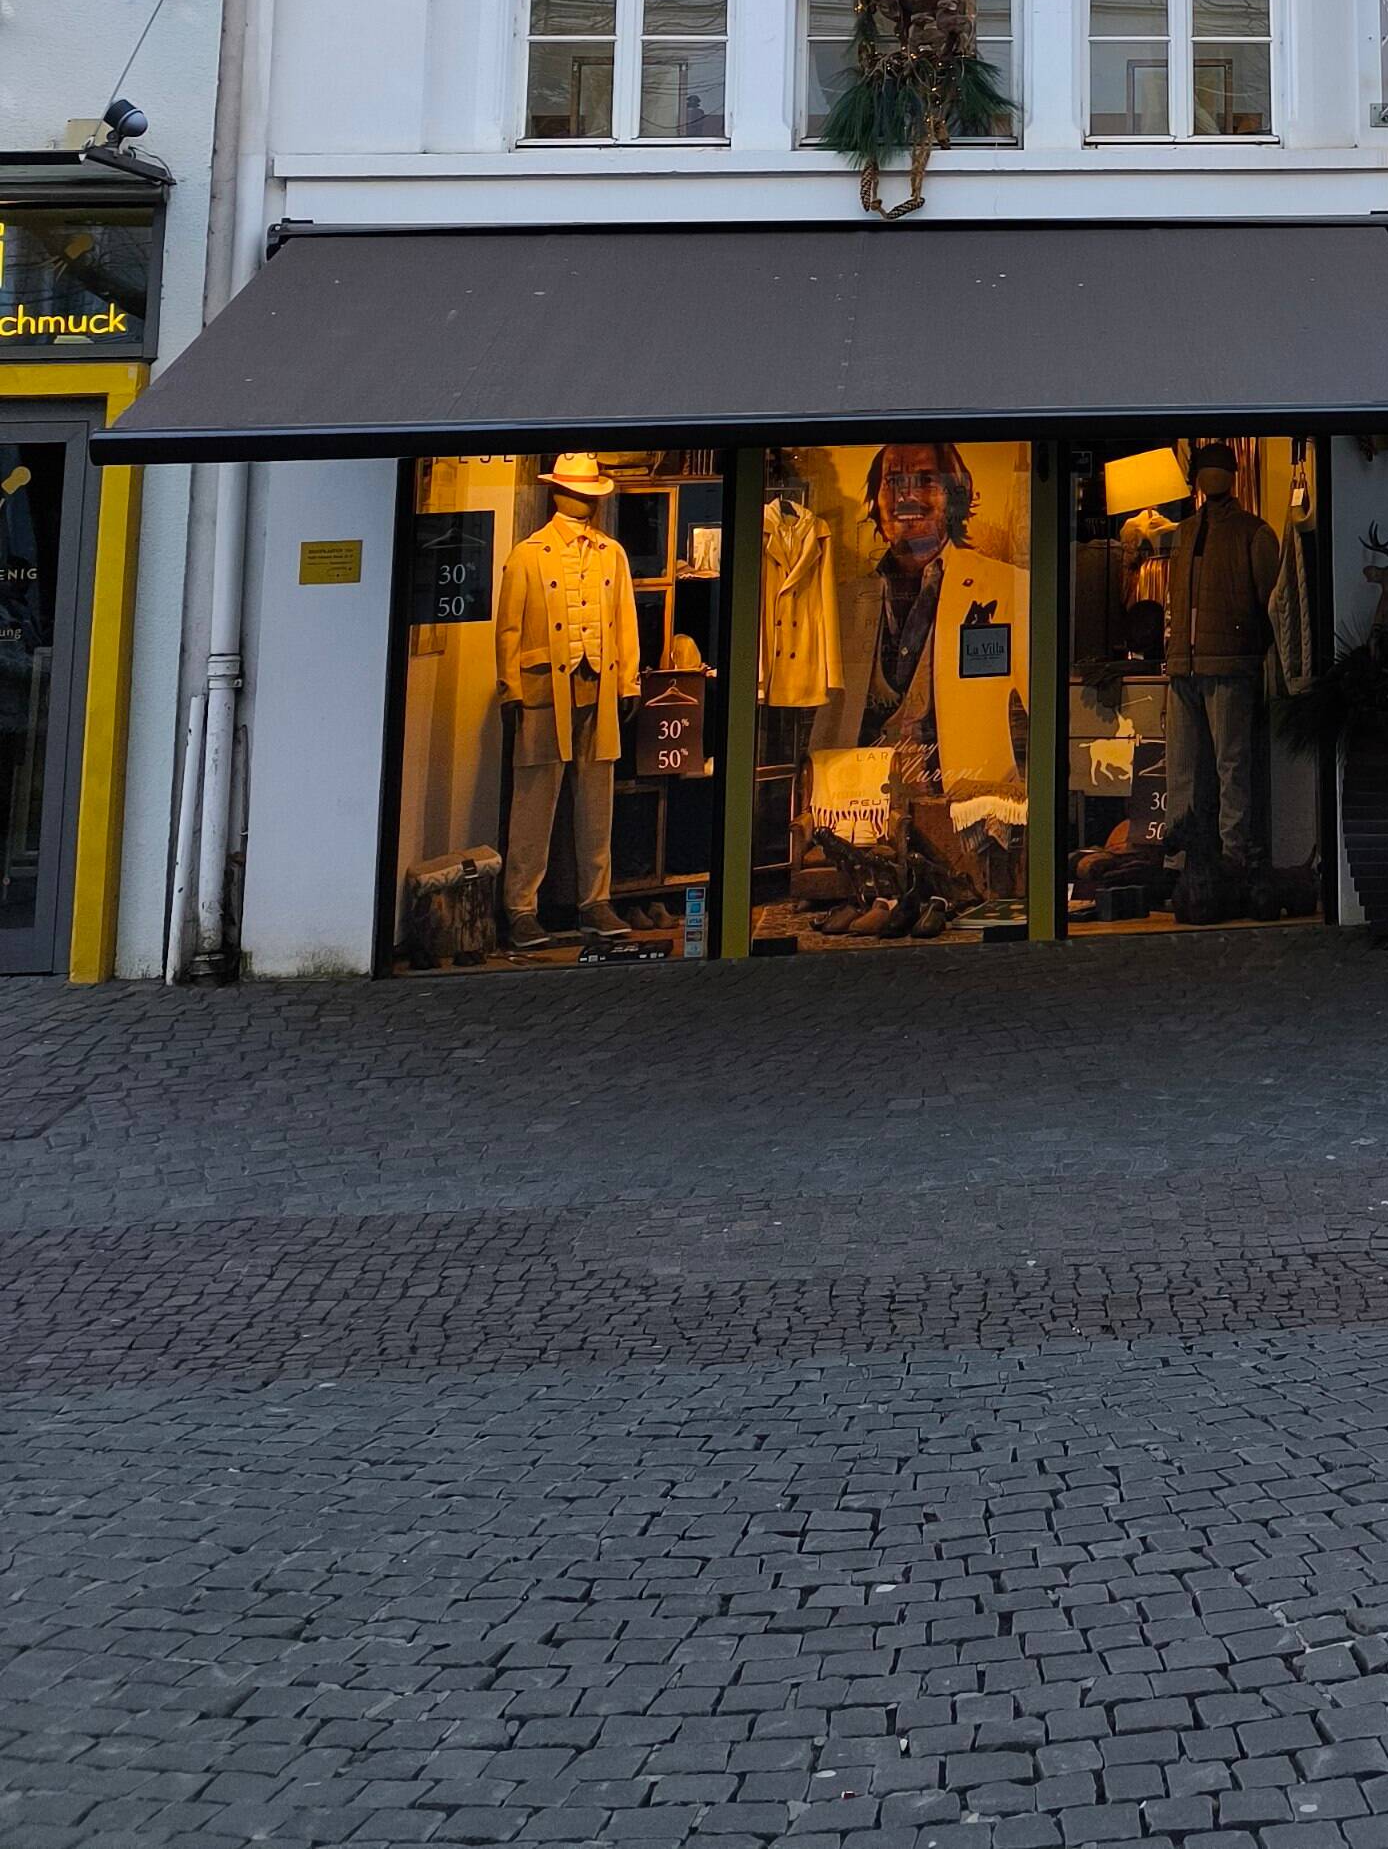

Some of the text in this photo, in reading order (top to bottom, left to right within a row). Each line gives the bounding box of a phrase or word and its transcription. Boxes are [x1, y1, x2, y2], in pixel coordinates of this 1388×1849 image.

[965, 641, 1005, 655] La Villa
[657, 718, 690, 740] 30%
[657, 747, 689, 769] 50%
